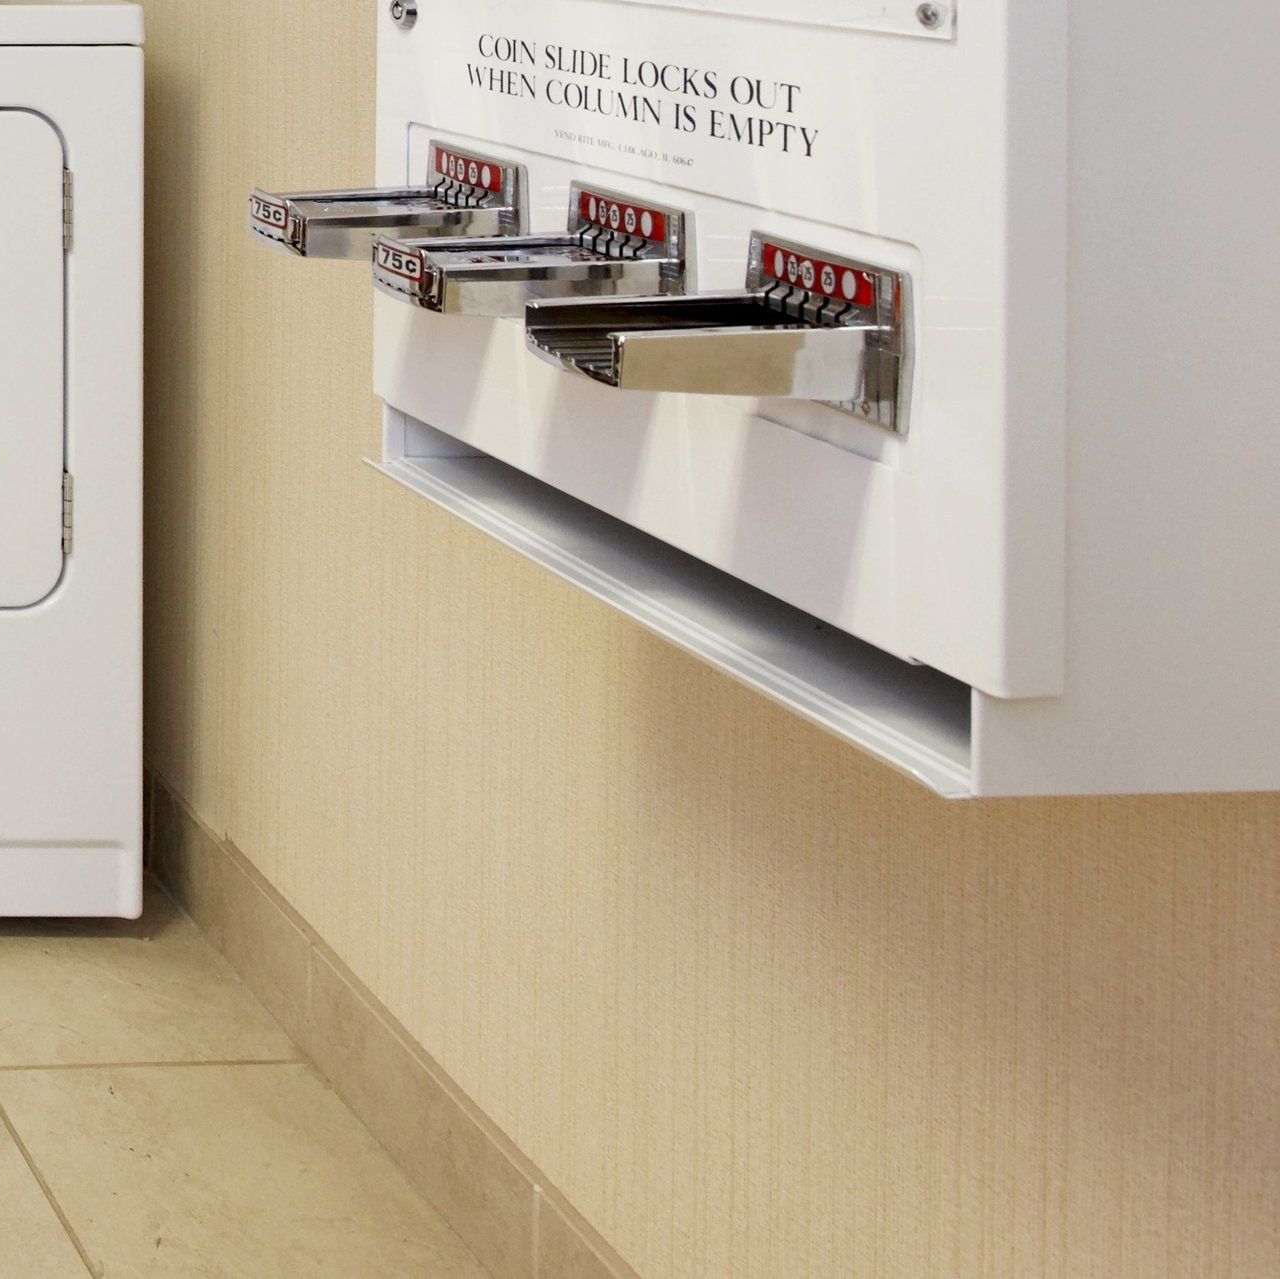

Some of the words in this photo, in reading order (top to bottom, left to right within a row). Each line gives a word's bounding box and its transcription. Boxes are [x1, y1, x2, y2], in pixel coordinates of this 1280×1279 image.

[478, 33, 536, 65] COIN
[544, 44, 611, 80] SLIDE
[622, 57, 717, 99] LOCKS
[730, 75, 801, 113] OUT
[467, 63, 536, 99] WHEN
[546, 79, 661, 126] COLUMN
[674, 103, 697, 133] IS
[709, 109, 819, 157] EMPTY
[554, 129, 576, 141] VEND
[577, 134, 594, 145] RITE
[253, 200, 283, 222] 75¢
[626, 212, 634, 226] 25
[381, 247, 417, 274] 75¢
[823, 270, 833, 287] 25
